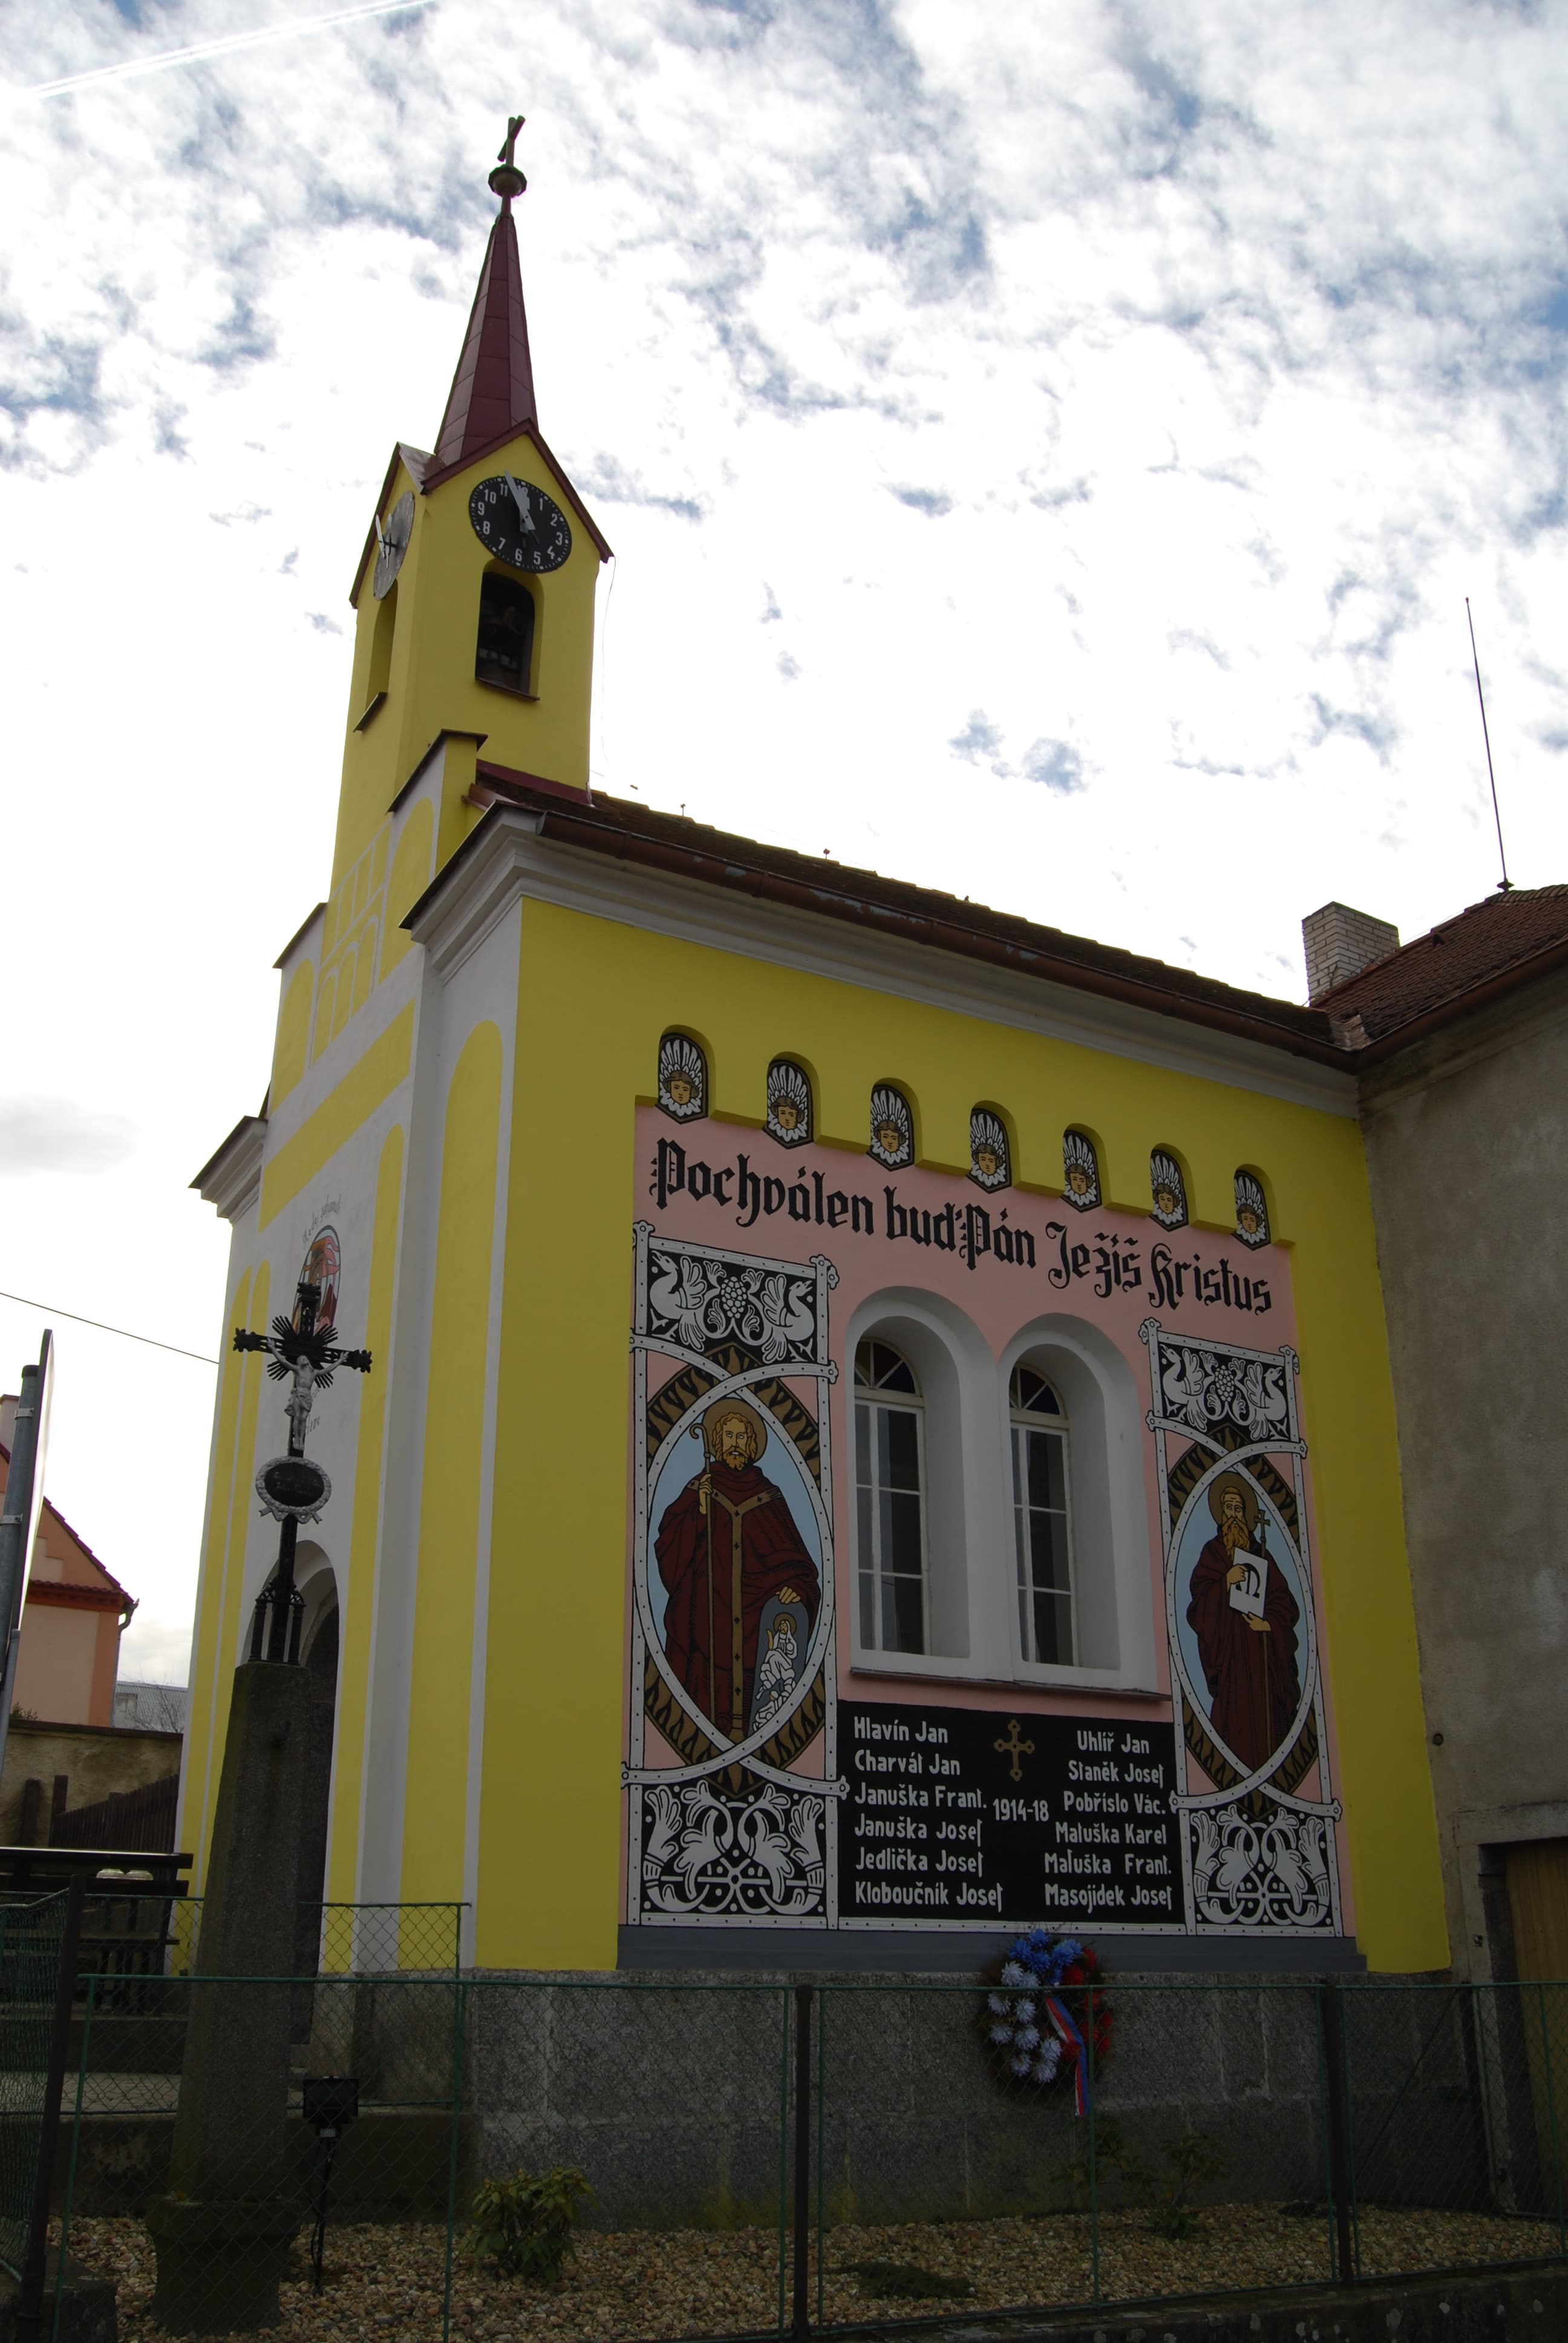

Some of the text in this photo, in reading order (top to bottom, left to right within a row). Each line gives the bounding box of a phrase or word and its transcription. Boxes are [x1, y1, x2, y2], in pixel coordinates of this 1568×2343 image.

[484, 489, 497, 503] 10
[500, 483, 508, 497] 11
[477, 502, 485, 516] 9
[538, 498, 543, 511] 1
[483, 521, 490, 535] 8
[550, 514, 558, 526] 2
[498, 537, 506, 549] 7
[555, 532, 563, 545] 3
[515, 548, 522, 562] 6
[534, 551, 541, 565] 5
[547, 546, 555, 559] 4
[649, 1137, 874, 1236] Pochválen
[959, 1204, 1036, 1270] Pán
[1045, 1222, 1142, 1298] Ježíš
[1148, 1243, 1271, 1316] Kristus
[854, 1717, 947, 1743] Hlavín Jan
[1077, 1731, 1149, 1754] Uhlíř Jan
[855, 1749, 960, 1775] Charvát Jan
[1069, 1760, 1163, 1788] Staněk Josef
[855, 1782, 987, 1808] Januška Frant.
[1064, 1791, 1166, 1814] Pobříslo Vác.
[993, 1799, 1049, 1821] 1914-18
[855, 1814, 982, 1847] Januška Josef
[1056, 1822, 1166, 1844] Matuška Karel
[856, 1847, 983, 1877] Jedlička Josef
[1045, 1849, 1171, 1875] Matuška Frant.
[856, 1881, 1003, 1912] Kloboučník Josef
[1131, 1886, 1172, 1910] Josef
